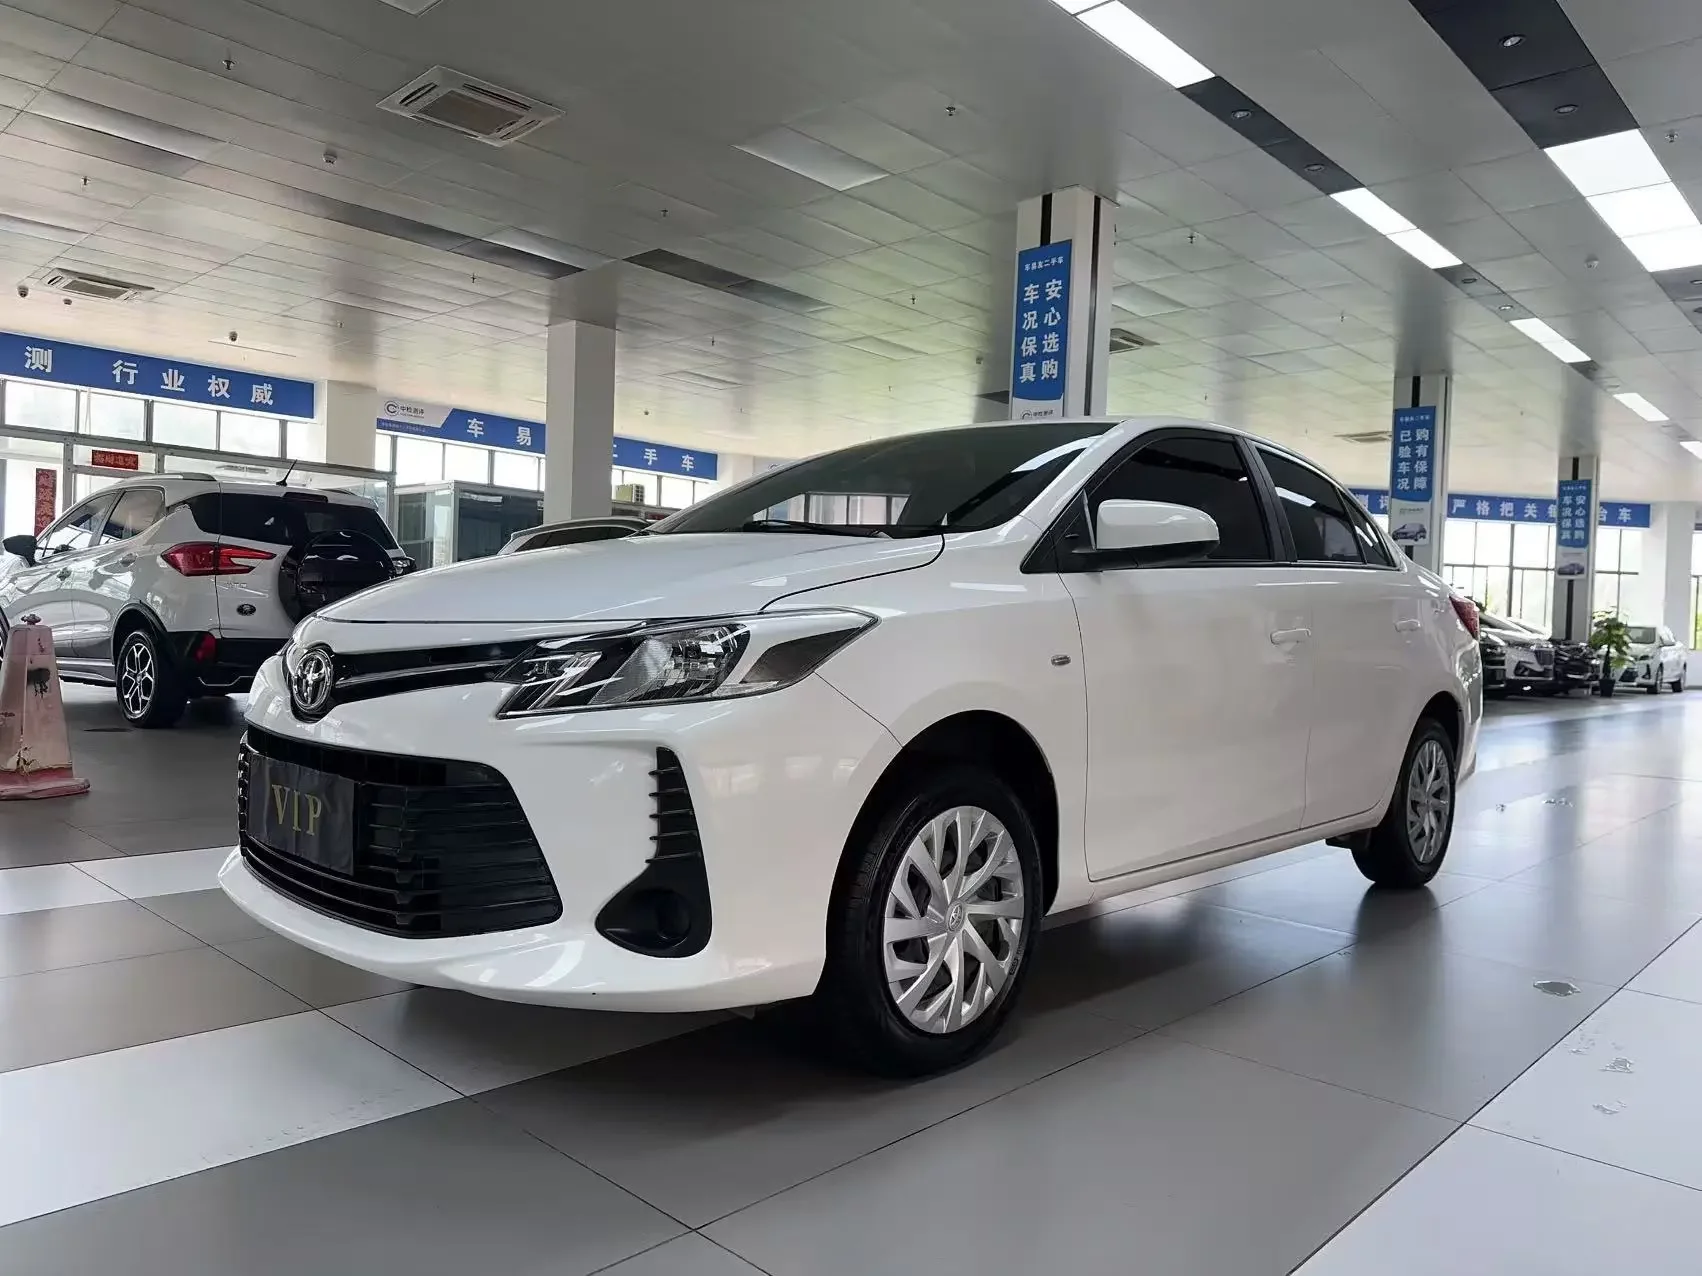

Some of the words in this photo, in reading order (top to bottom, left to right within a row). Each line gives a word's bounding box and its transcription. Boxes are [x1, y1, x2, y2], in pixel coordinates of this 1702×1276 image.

[1019, 284, 1040, 384] 车况保真
[1041, 279, 1063, 381] 安心选购
[112, 359, 274, 406] 行业权威
[271, 784, 322, 836] VIP
